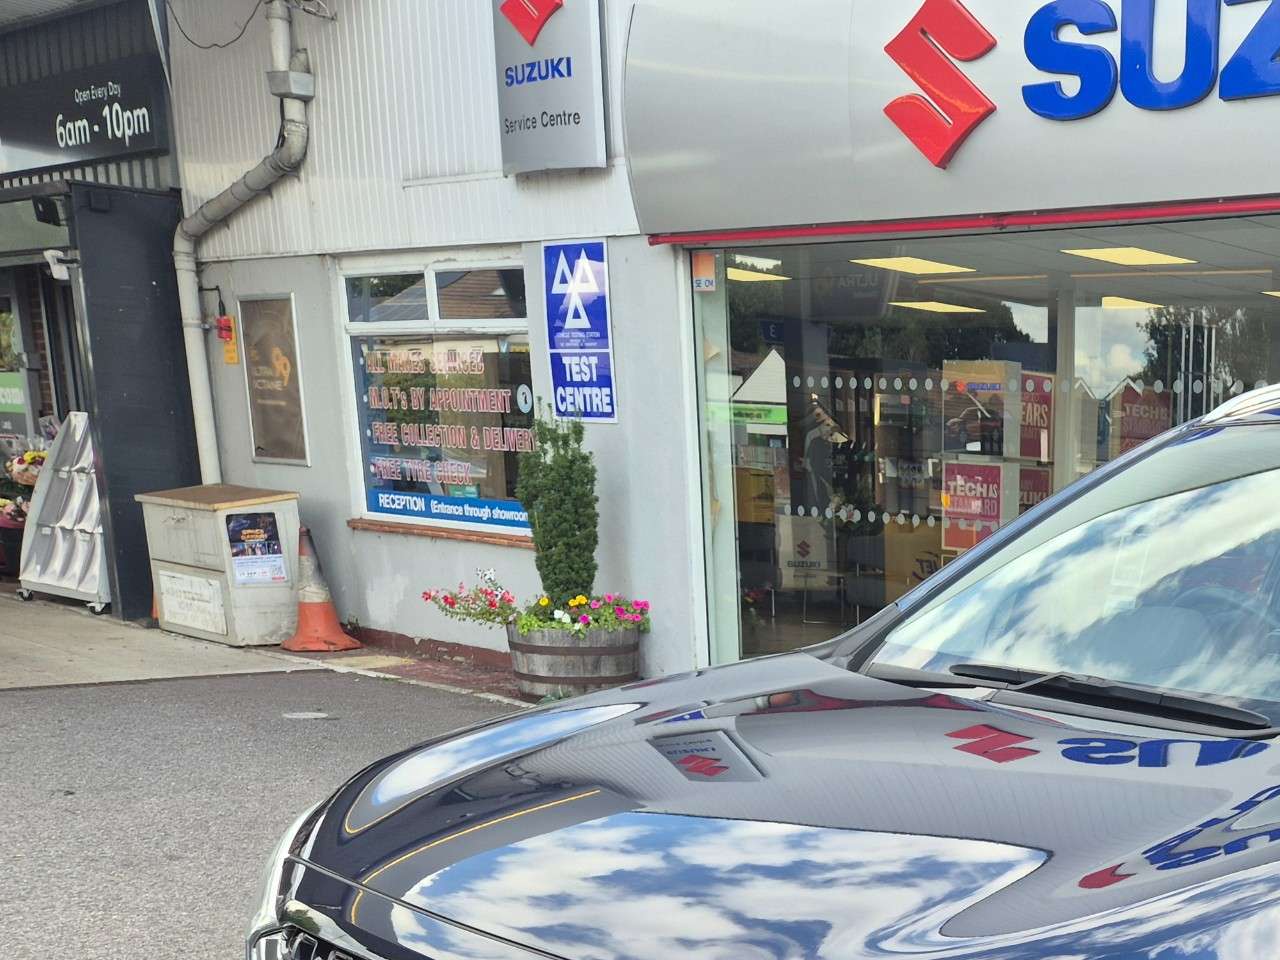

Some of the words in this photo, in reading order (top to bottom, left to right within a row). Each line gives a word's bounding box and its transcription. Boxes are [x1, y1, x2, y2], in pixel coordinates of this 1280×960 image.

[505, 56, 572, 87] SUZUKI
[74, 89, 90, 105] Open
[91, 85, 107, 100] Every
[108, 81, 121, 97] Day
[56, 114, 90, 148] 6am
[102, 102, 150, 147] 10pm
[504, 116, 537, 135] Service
[541, 110, 581, 128] Centre
[366, 352, 385, 373] ALL
[562, 355, 598, 382] TEST
[410, 387, 425, 410] BY
[429, 388, 511, 413] APPOINTMENT
[556, 386, 612, 412] CENTRE
[1021, 402, 1049, 427] EARS
[372, 421, 398, 445] FREE
[399, 423, 467, 449] COLLECTION
[470, 426, 480, 450] &
[483, 426, 537, 452] DELIVERY
[374, 456, 401, 480] FREE
[404, 458, 432, 483] TYRE
[947, 481, 987, 497] TECH
[378, 493, 425, 512] RECEPTION
[430, 500, 464, 515] (Entrance
[464, 504, 492, 520] through
